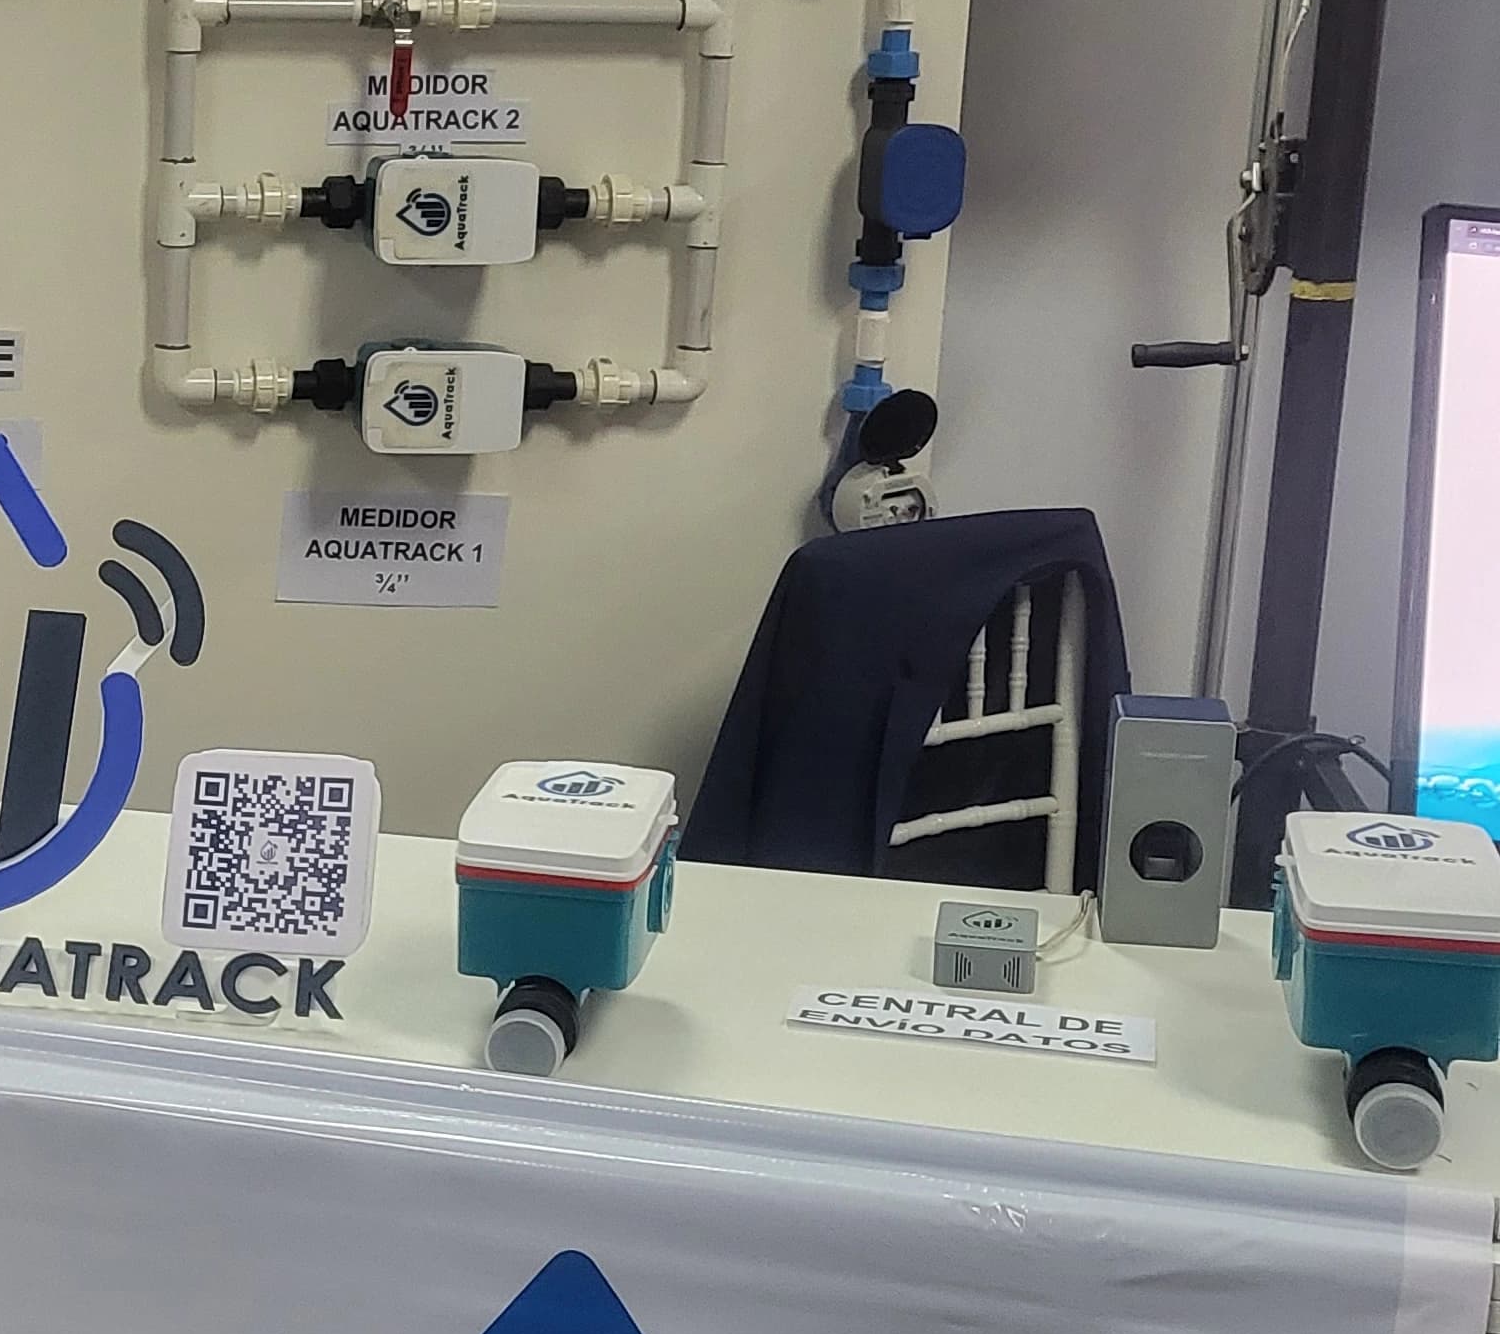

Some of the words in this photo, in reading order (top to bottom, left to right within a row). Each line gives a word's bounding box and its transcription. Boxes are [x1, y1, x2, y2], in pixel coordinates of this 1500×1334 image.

[368, 74, 488, 95] MDIDOR
[333, 110, 498, 131] AQUATRACK
[506, 109, 519, 130] 2
[454, 175, 469, 250] AquaTrack
[442, 367, 456, 440] AquaTrack
[340, 507, 456, 530] MEDIDOR
[305, 540, 464, 562] AQUATRACK
[472, 544, 483, 563] 1
[501, 791, 637, 811] AquaTrack
[1322, 846, 1477, 867] AquaTrack
[818, 993, 1041, 1027] CENTRAL
[1059, 1015, 1124, 1035] DE
[963, 1028, 1131, 1054] DATOS
